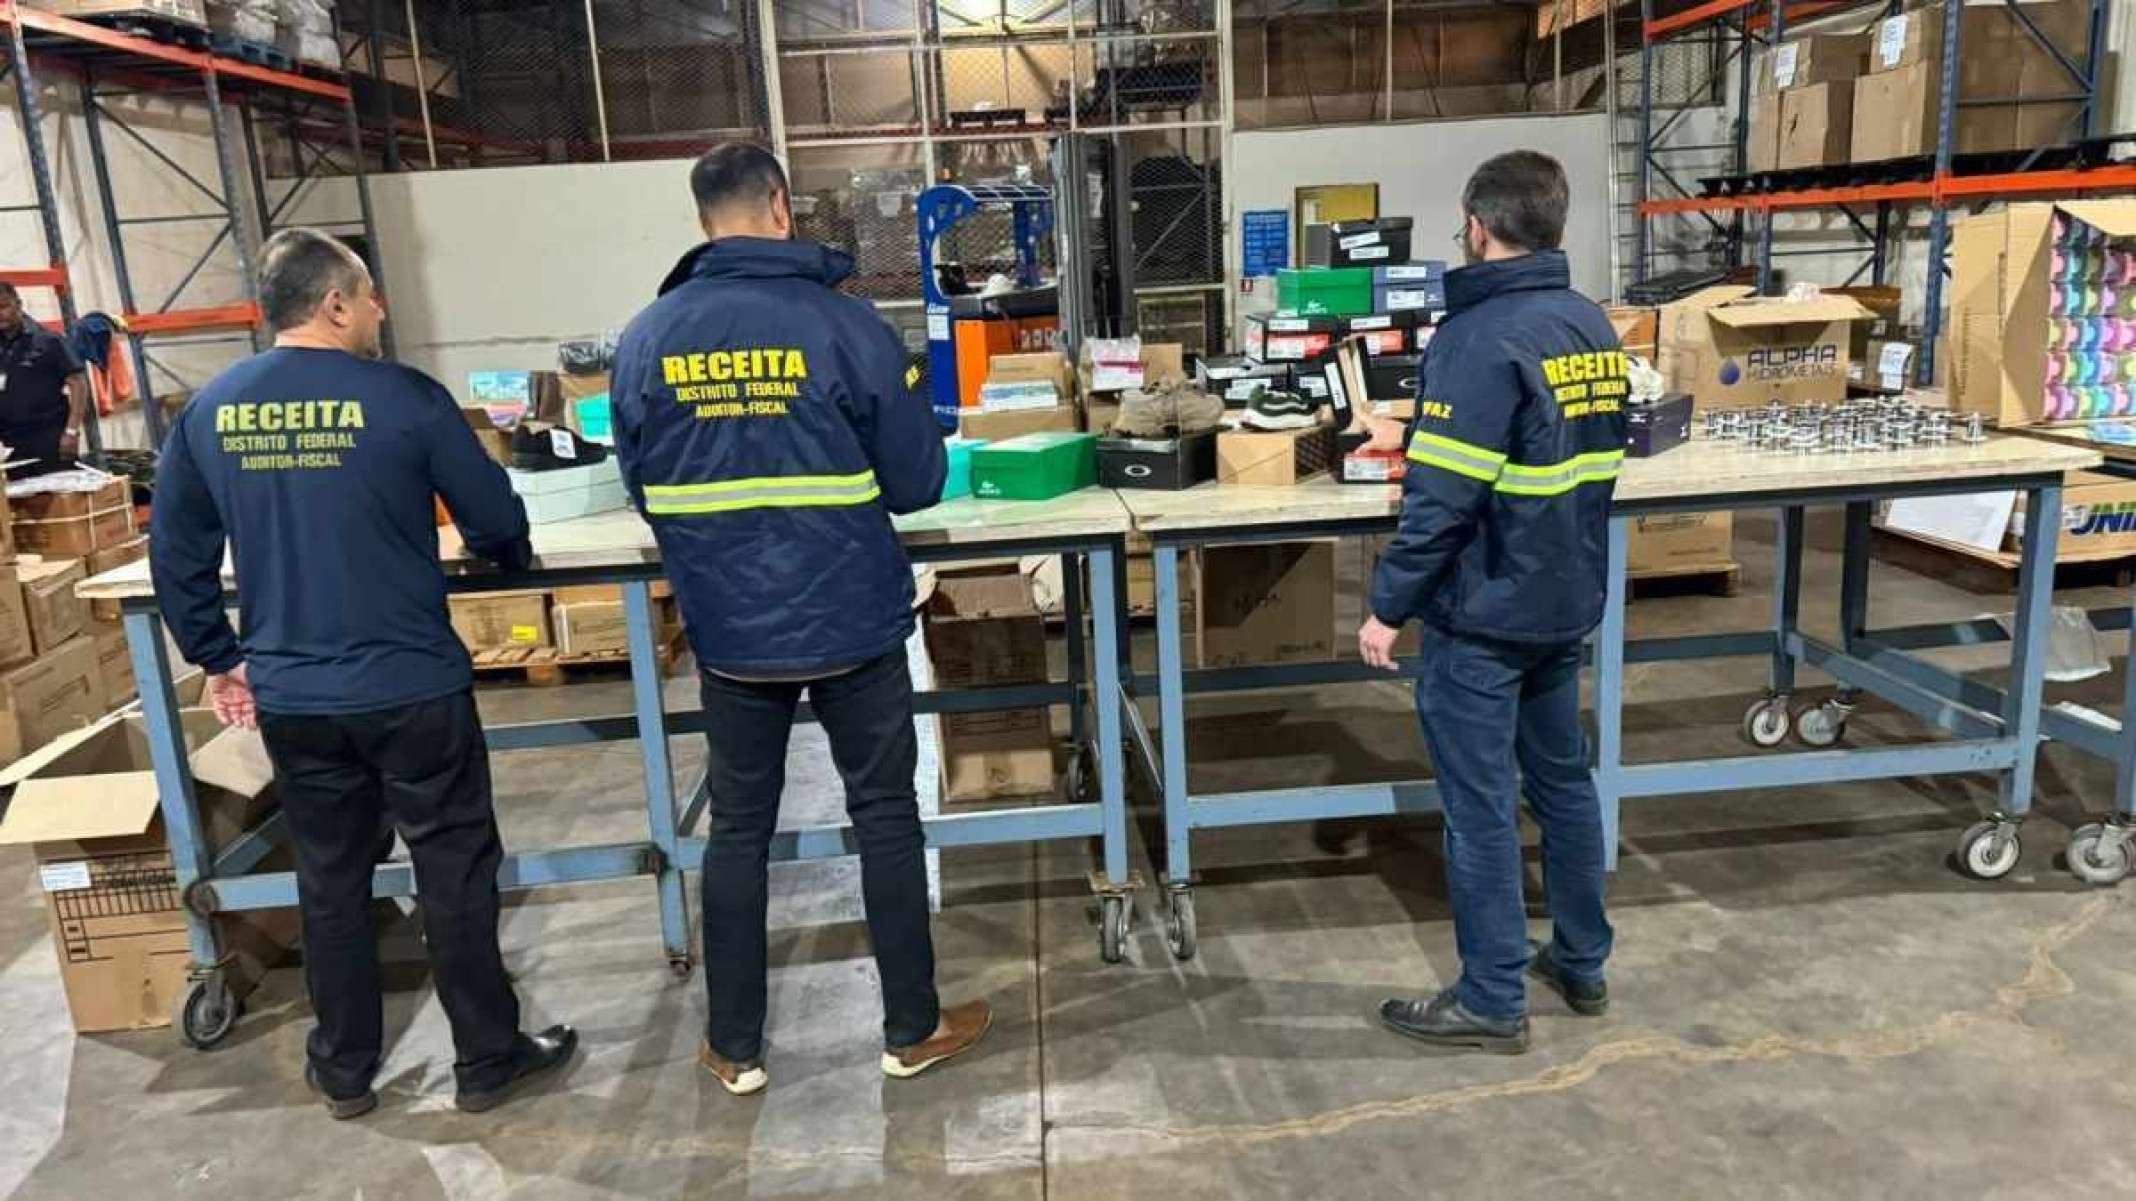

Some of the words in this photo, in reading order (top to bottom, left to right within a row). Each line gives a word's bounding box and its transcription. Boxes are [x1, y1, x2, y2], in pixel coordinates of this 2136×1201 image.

[1747, 344, 1837, 368] ALPHA
[661, 349, 808, 385] RECEITA
[676, 384, 737, 402] DISTRITO
[745, 381, 800, 398] FEDERAL
[215, 400, 365, 433] RECEITA
[695, 401, 788, 418] AUDITOR-FISCAL
[223, 433, 287, 452] DISTRITO
[296, 431, 357, 449] FEDERAL
[241, 452, 342, 471] AUDITOR-FISCAL
